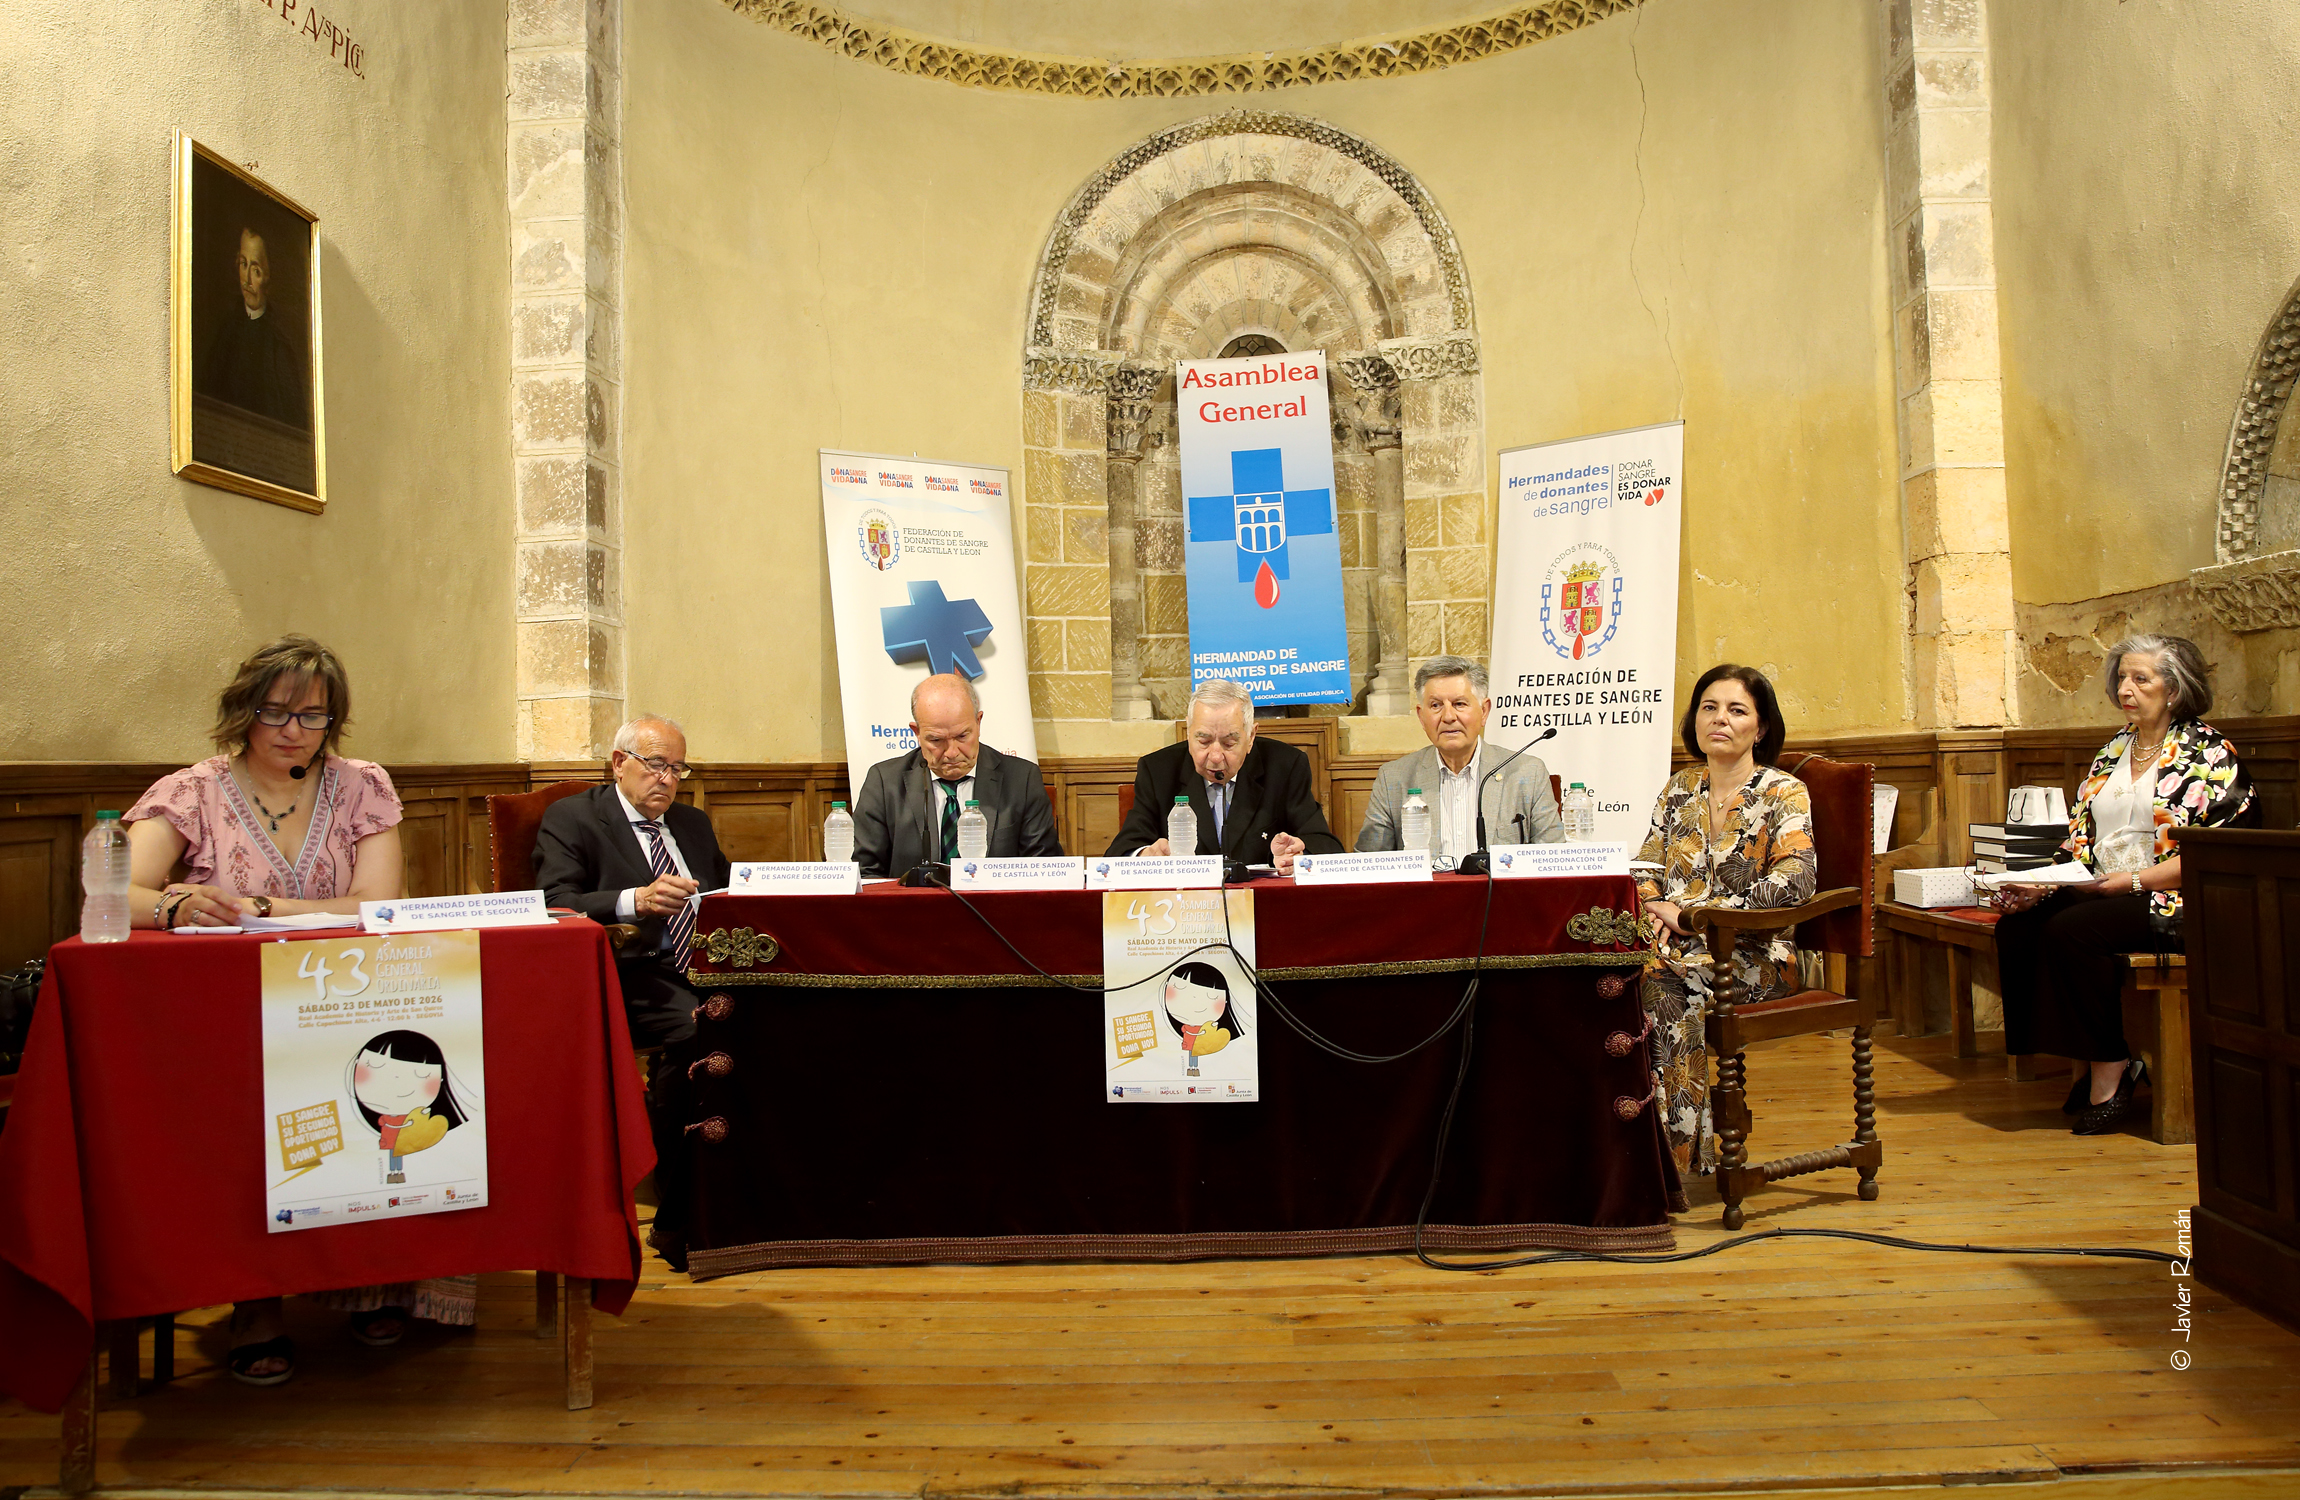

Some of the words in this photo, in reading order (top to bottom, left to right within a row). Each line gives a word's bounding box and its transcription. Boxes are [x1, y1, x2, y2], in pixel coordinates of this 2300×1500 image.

[1182, 362, 1319, 389] Asamblea
[1199, 395, 1307, 423] General
[1618, 458, 1653, 472] DONAR
[1508, 464, 1610, 488] Hermandades
[1618, 468, 1656, 482] SANGRE
[1524, 489, 1538, 502] de
[1540, 480, 1609, 499] donantes
[1618, 481, 1629, 492] ES
[1632, 476, 1671, 489] DONAR
[1617, 490, 1643, 500] VIDA
[1534, 506, 1548, 518] de
[1550, 496, 1608, 516] sangre
[902, 528, 951, 537] FEDERACIÓN
[953, 530, 964, 538] DE
[904, 536, 945, 546] DONANTES
[958, 540, 988, 548] SANGRE
[917, 546, 952, 554] CASTILLA
[1193, 650, 1277, 664] HERMANDAD
[1279, 648, 1298, 660] DE
[1194, 665, 1267, 679] DONANTES
[1269, 664, 1288, 676] DE
[1290, 660, 1346, 674] SANGRE
[1518, 667, 1612, 688] FEDERACIÓN
[1617, 669, 1637, 682] DE
[1254, 692, 1287, 700] ASOCIACIÓN
[1496, 693, 1571, 708] DONANTES
[1575, 692, 1594, 705] DE
[1600, 689, 1662, 705] SANGRE
[1501, 715, 1518, 728] DE
[1523, 712, 1592, 728] CASTILLA
[1599, 712, 1607, 724] Y
[1612, 706, 1653, 724] LEÓN
[1598, 800, 1630, 812] León
[983, 862, 1028, 870] CONSEJERÍA
[1176, 858, 1216, 866] DONANTES
[1316, 857, 1362, 866] FEDERACIÓN
[1375, 856, 1413, 864] DONANTES
[1362, 864, 1396, 872] CASTILLA
[1404, 862, 1422, 870] LEÓN
[1532, 855, 1594, 864] HEMODONACIÓN
[1048, 869, 1067, 877] LEÓN
[401, 901, 465, 912] HERMANDAD
[468, 900, 481, 908] DE
[484, 896, 537, 906] DONANTES
[1180, 899, 1220, 910] ASAMBLEA
[411, 912, 424, 920] DE
[428, 910, 468, 919] SANGRE
[471, 909, 484, 917] DE
[486, 907, 530, 916] SEGOVIA
[1126, 898, 1177, 937] 43
[1180, 910, 1214, 922] GENERAL
[1127, 938, 1156, 946] SÁBADO
[376, 946, 433, 962] ASAMBLEA
[297, 947, 372, 1000] 43
[376, 960, 425, 978] GENERAL
[376, 976, 441, 994] ORDINARIA
[298, 1002, 340, 1014] SÁBADO
[343, 1000, 355, 1010] 23
[358, 1000, 370, 1009] DE
[374, 998, 400, 1008] MAYO
[404, 996, 416, 1006] DE
[418, 995, 443, 1004] 2026
[1115, 1018, 1124, 1026] TU
[1116, 1026, 1124, 1034] SU
[1126, 1022, 1152, 1033] SEGUNDA
[1118, 1030, 1154, 1042] OPORTUNIDAD
[1121, 1042, 1140, 1055] DONA
[1141, 1038, 1154, 1049] HOY
[280, 1115, 293, 1126] TU
[295, 1104, 334, 1122] SANGRE.
[282, 1127, 294, 1138] SU
[297, 1117, 336, 1135] SEGUNDA
[284, 1126, 338, 1148] OPORTUNIDAD
[289, 1146, 317, 1165] DONA
[320, 1138, 339, 1154] HOY
